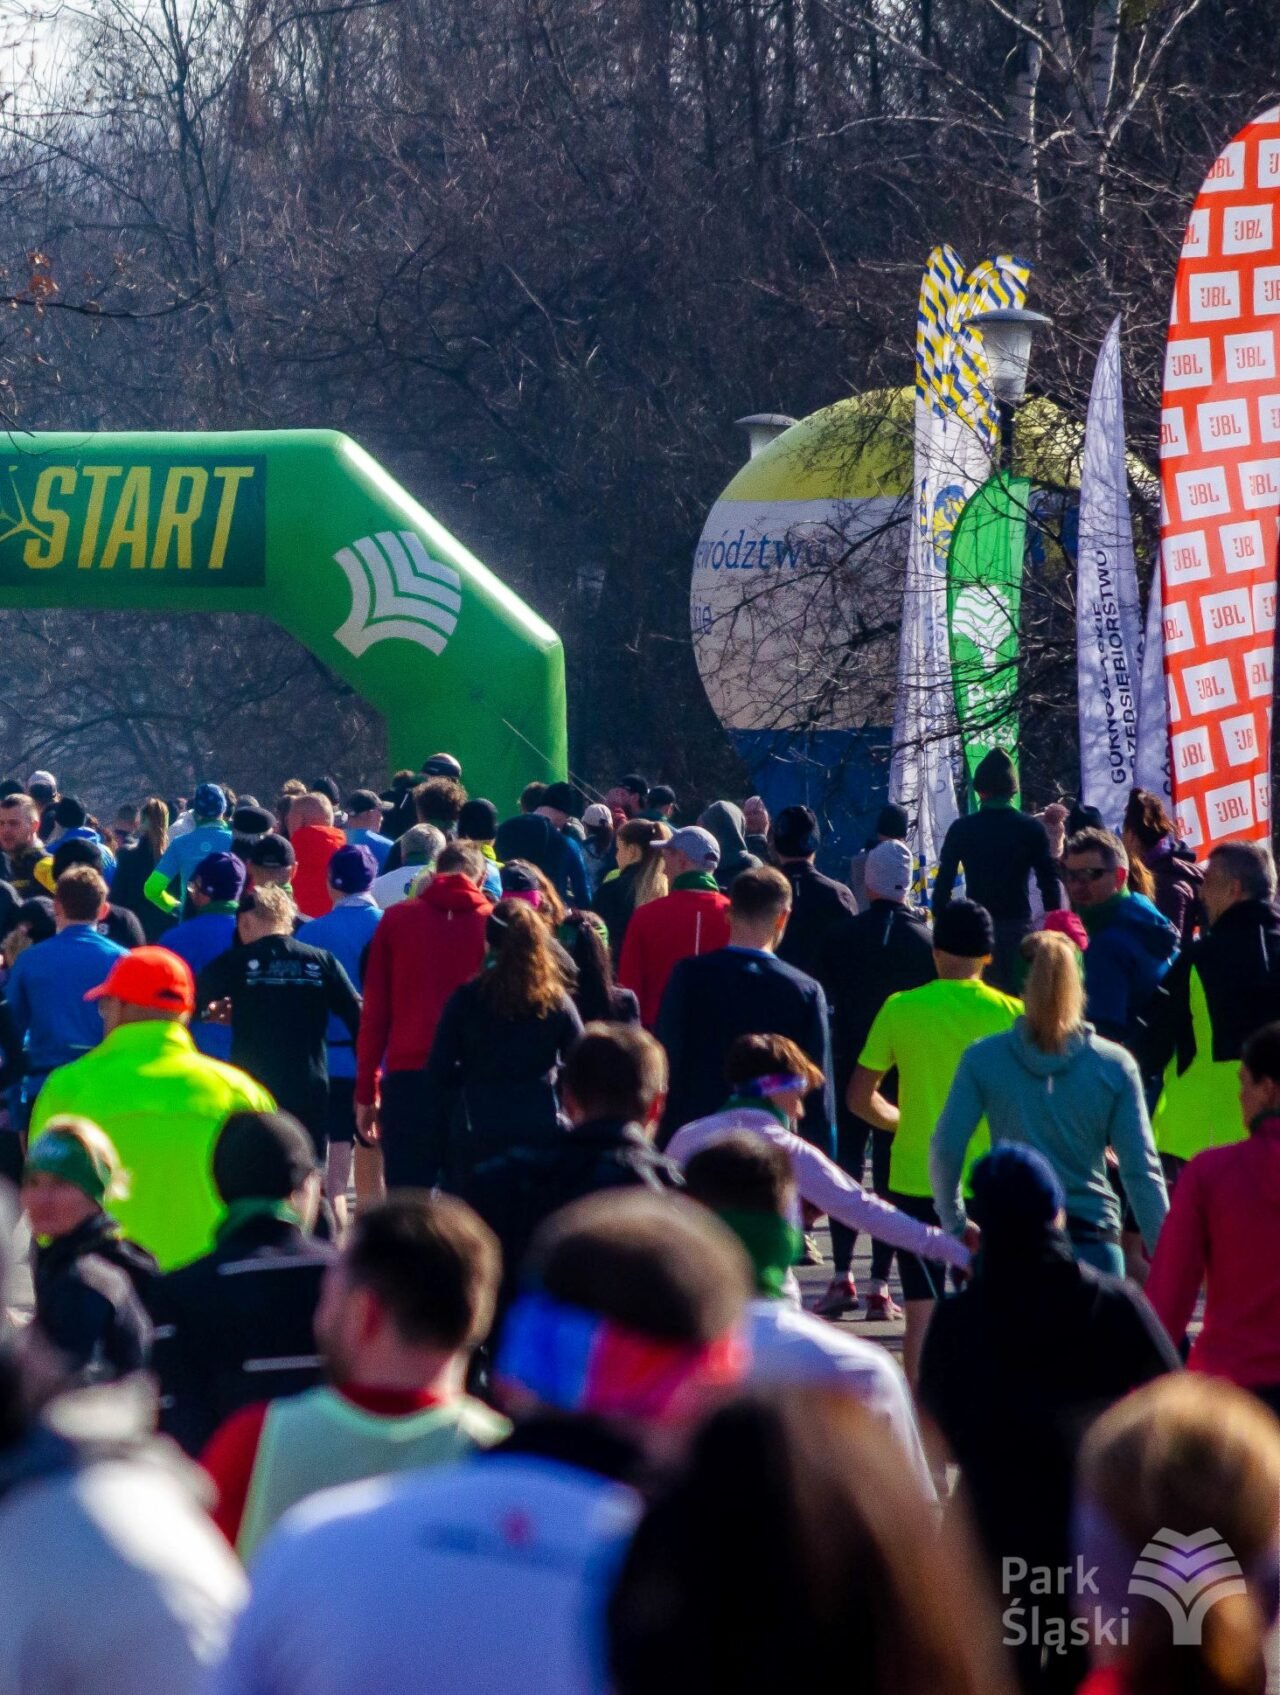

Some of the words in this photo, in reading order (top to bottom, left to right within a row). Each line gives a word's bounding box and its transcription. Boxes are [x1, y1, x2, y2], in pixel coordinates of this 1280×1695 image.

[1184, 224, 1199, 245] BL
[1236, 219, 1263, 241] JBL
[1202, 286, 1231, 308] JBL
[1265, 280, 1280, 301] JB
[1174, 354, 1203, 376] JBL
[1237, 346, 1266, 369] JBL
[1161, 424, 1179, 445] BL
[1211, 414, 1242, 438] JBL
[1190, 483, 1220, 506] JBL
[1250, 473, 1278, 496] JBL
[23, 466, 254, 569] START
[1234, 536, 1255, 559] JB
[1174, 547, 1201, 572] JBL
[1212, 604, 1246, 630] JBL
[1251, 662, 1271, 685] BL
[1197, 676, 1225, 700] JBL
[1236, 728, 1254, 751] JB
[1217, 796, 1249, 823] JBL
